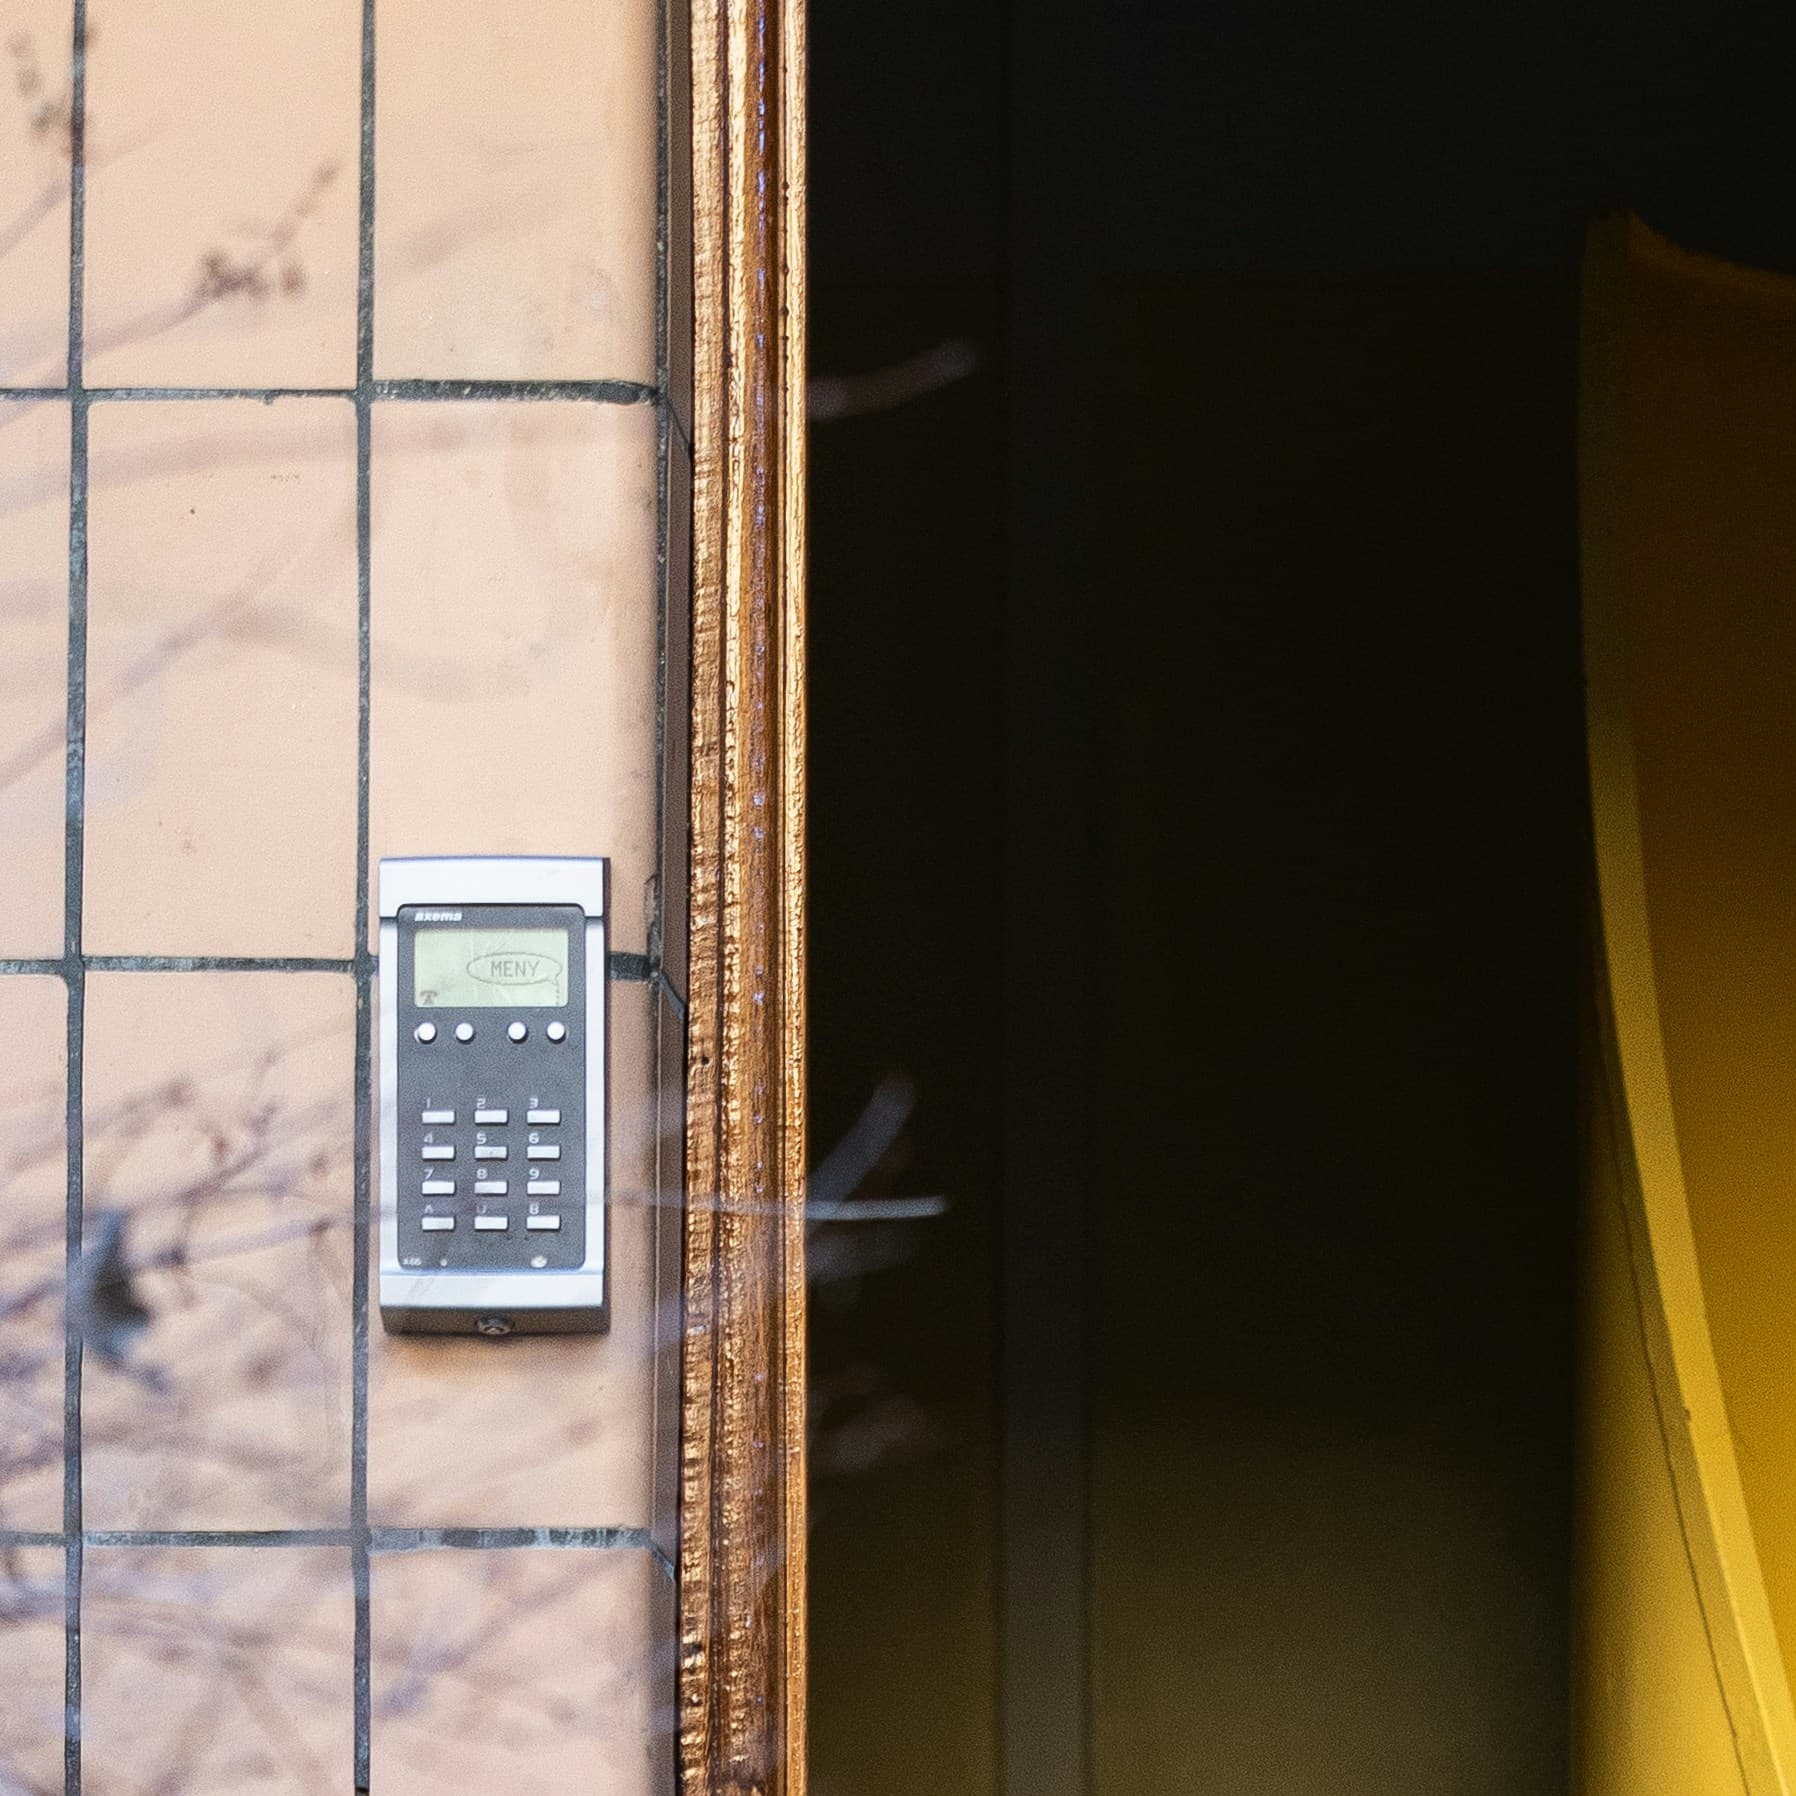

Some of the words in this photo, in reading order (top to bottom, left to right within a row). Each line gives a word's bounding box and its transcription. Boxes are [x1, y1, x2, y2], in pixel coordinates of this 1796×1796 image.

[490, 960, 541, 977] MENY
[476, 1098, 486, 1109] 2
[529, 1097, 539, 1109] 3
[423, 1133, 433, 1144] 4
[476, 1132, 487, 1145] 5
[528, 1132, 539, 1144] 6
[423, 1168, 434, 1179] 7
[476, 1168, 487, 1179] 8
[528, 1168, 540, 1180] 9
